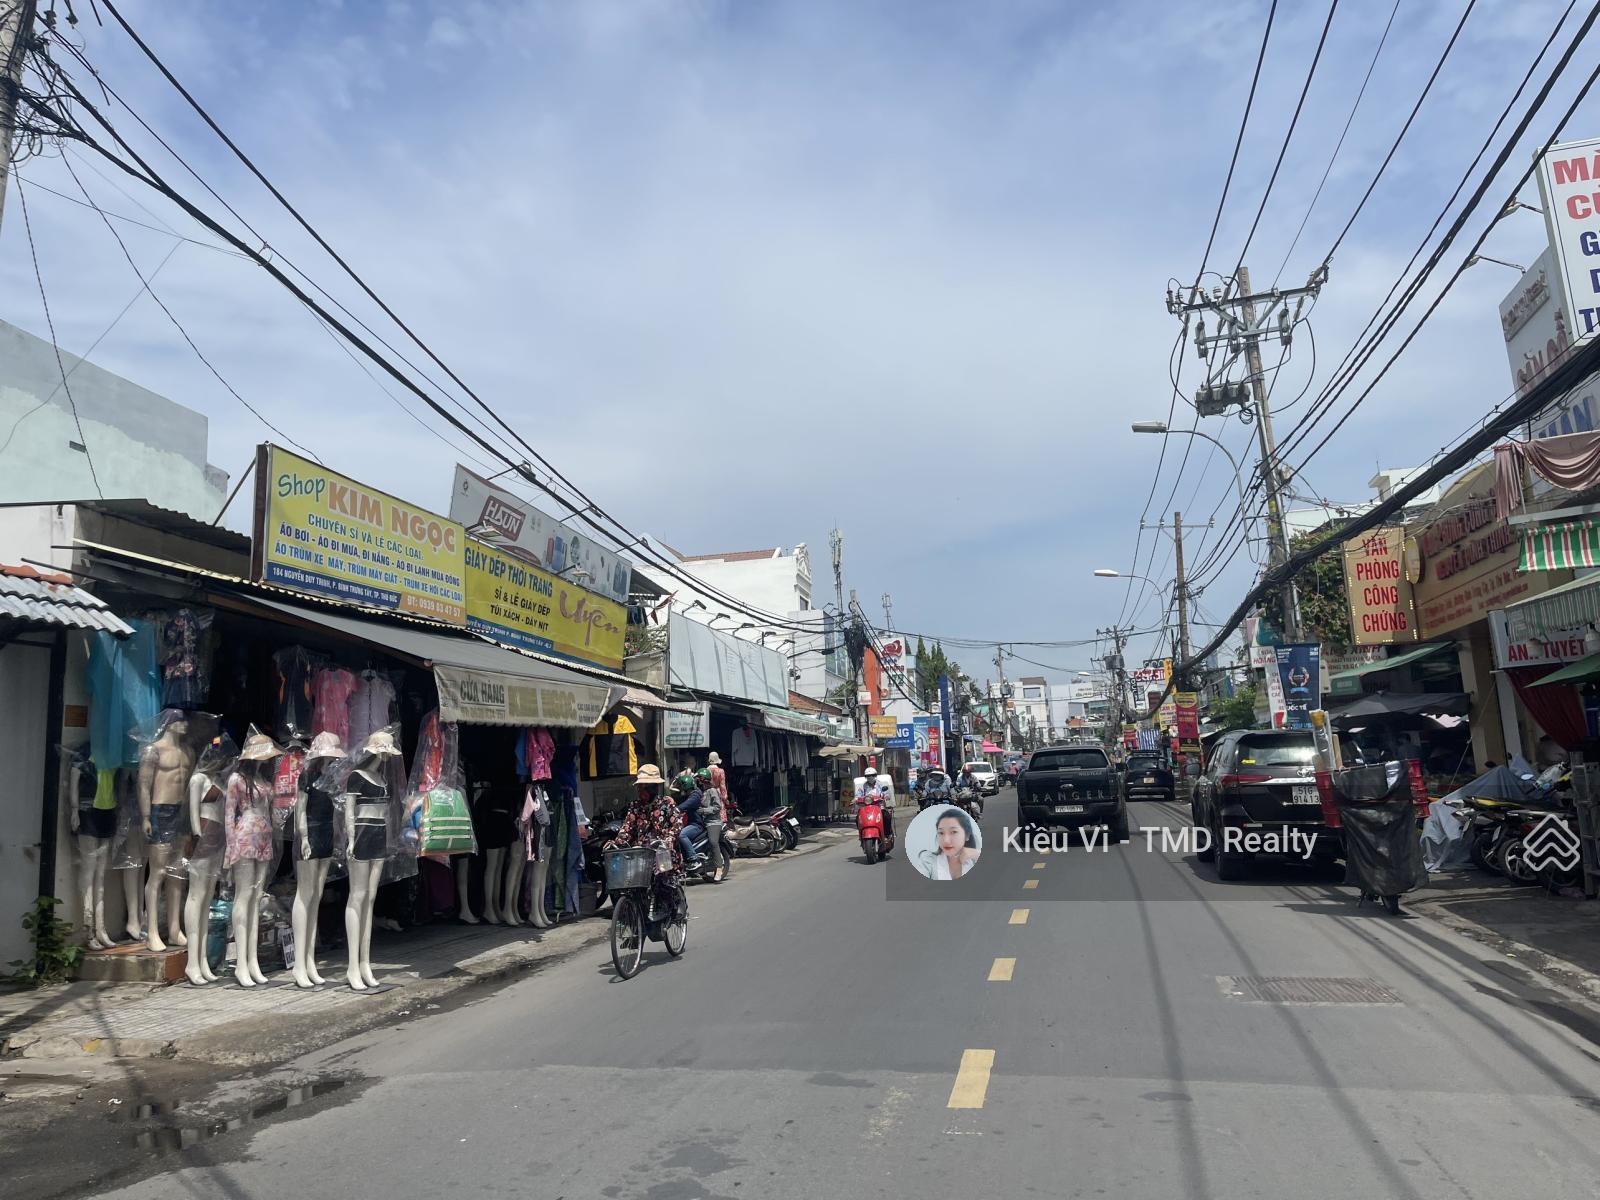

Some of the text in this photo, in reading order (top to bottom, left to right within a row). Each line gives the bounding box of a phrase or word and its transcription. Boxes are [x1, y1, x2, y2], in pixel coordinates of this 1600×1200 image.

[278, 473, 455, 554] Shop KIM NGỌC
[279, 522, 291, 536] ÁO
[294, 528, 308, 541] BƠI
[318, 534, 328, 547] ÁO
[331, 539, 339, 551] ĐI
[362, 548, 369, 560] ĐI
[308, 513, 345, 535] CHUYÊN
[361, 531, 371, 543] VÀ
[387, 540, 402, 553] CÁC
[1362, 535, 1388, 557] VĂN
[275, 541, 287, 555] ÁO
[288, 545, 311, 561] TRÙM
[314, 554, 323, 564] XE
[328, 556, 345, 571] MÁY,
[347, 562, 366, 576] TRÙM
[368, 568, 382, 580] MÁY
[421, 583, 427, 592] XE
[1356, 558, 1400, 581] PHÒNG
[528, 573, 553, 598] TRANG
[1363, 584, 1399, 606] CÔNG
[407, 597, 417, 606] ĐT:
[419, 599, 434, 610] 0939
[453, 607, 460, 616] 57
[503, 593, 508, 602] &
[559, 589, 621, 647] Uyên
[1362, 610, 1407, 633] CHỨNG
[1543, 634, 1585, 658] TUYẾT
[460, 675, 480, 702] CỬA
[481, 680, 505, 704] HÀNG
[1032, 789, 1105, 803] RANGER
[1298, 786, 1313, 795] 51G
